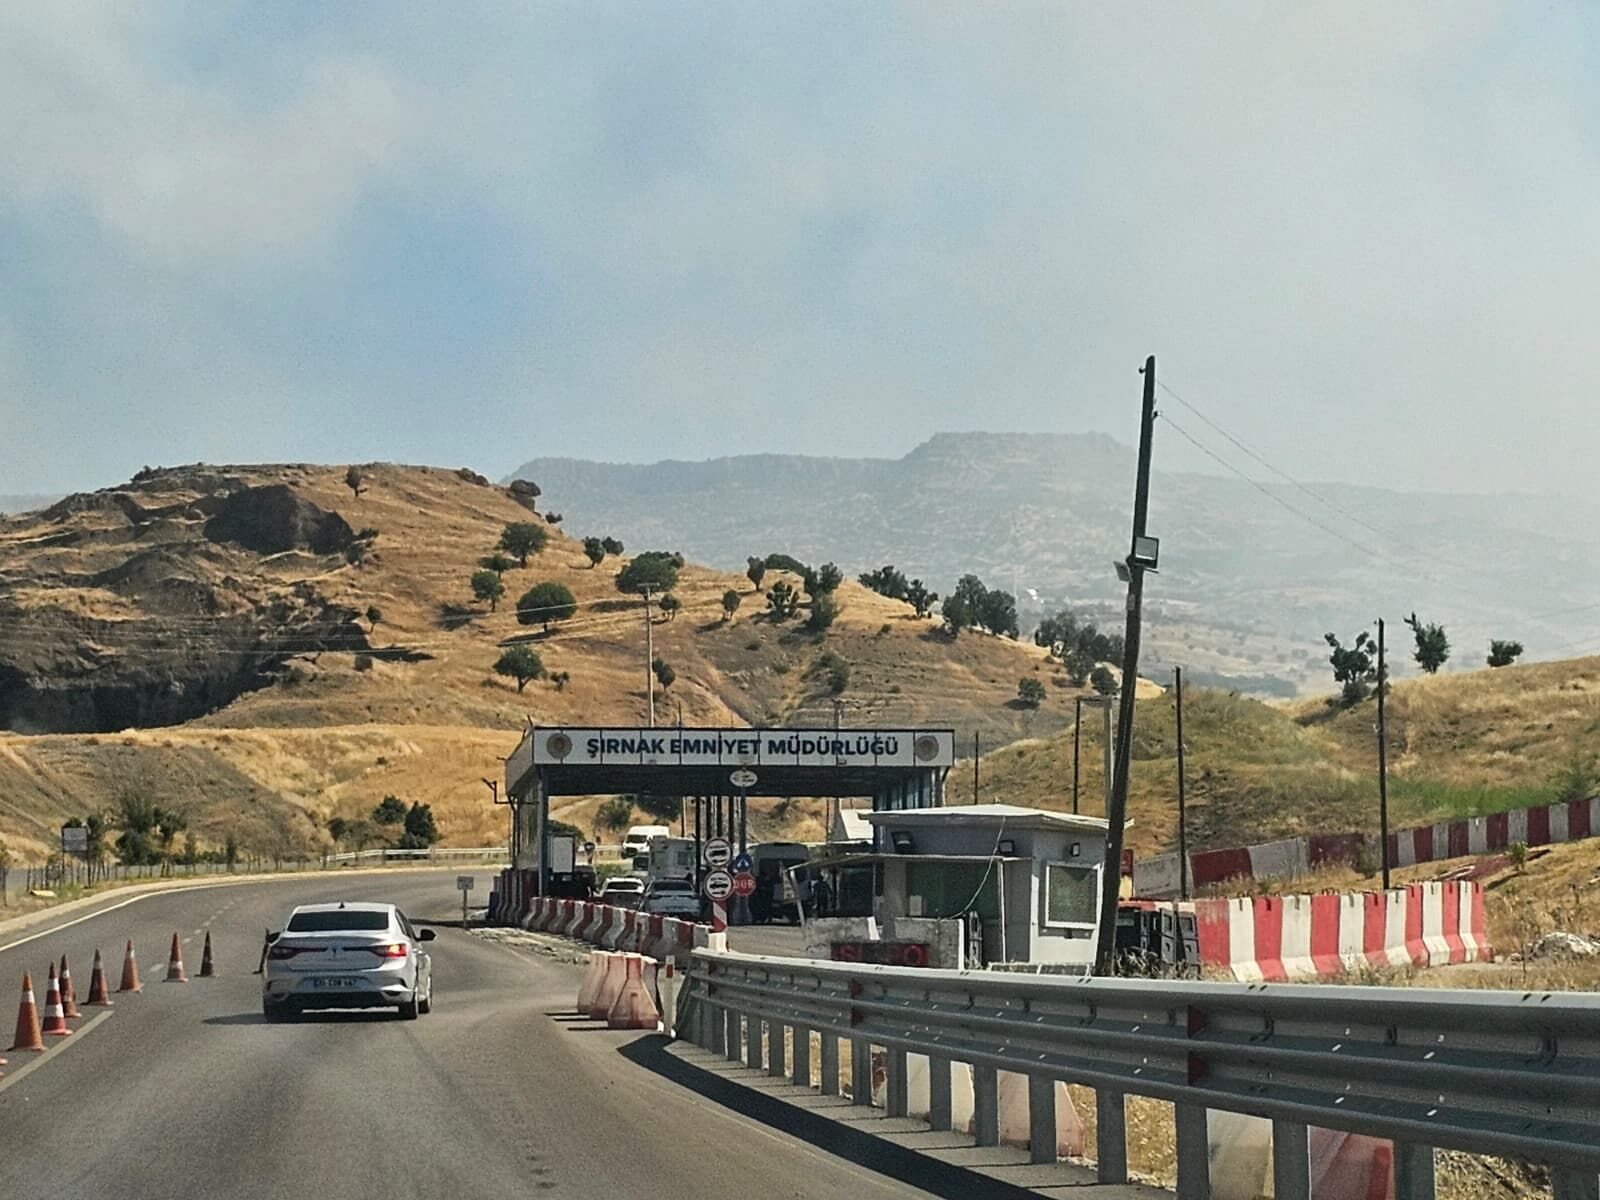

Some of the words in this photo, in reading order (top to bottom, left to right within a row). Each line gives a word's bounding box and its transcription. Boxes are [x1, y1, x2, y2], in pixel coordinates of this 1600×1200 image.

[587, 738, 665, 758] ŞIRNAK
[670, 735, 761, 755] EMNİYET
[767, 736, 898, 756] MÜDÜRLÜĞÜ
[733, 879, 754, 889] DUR
